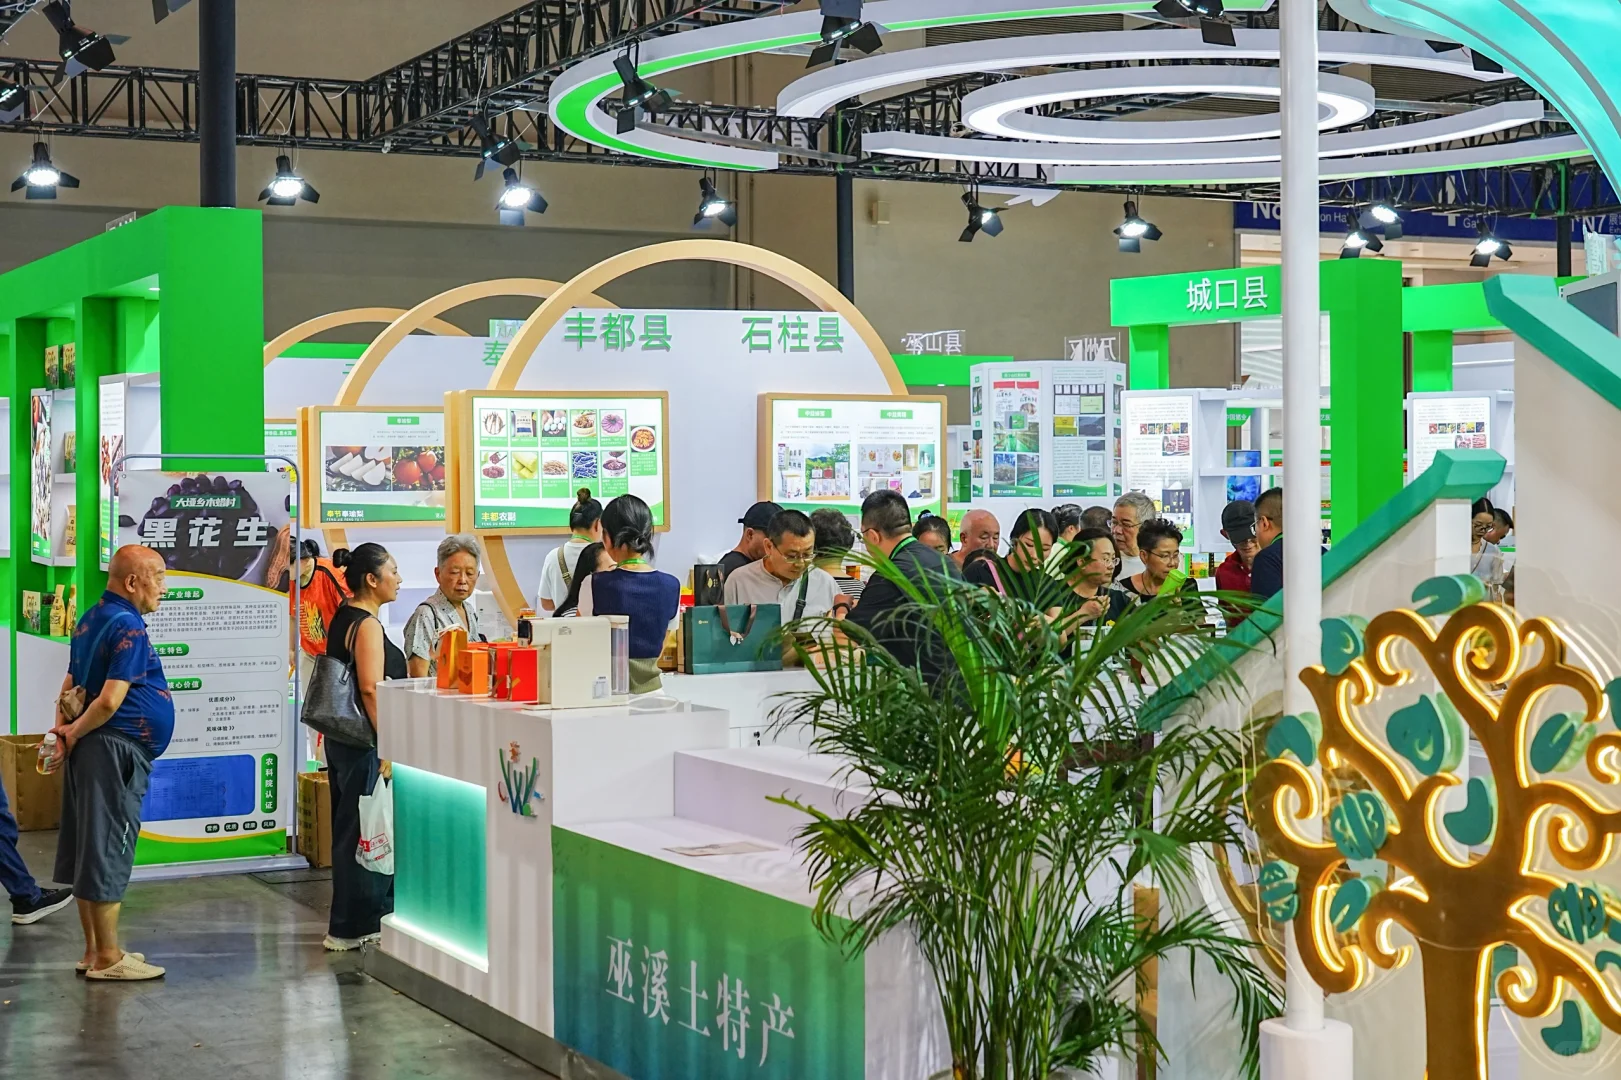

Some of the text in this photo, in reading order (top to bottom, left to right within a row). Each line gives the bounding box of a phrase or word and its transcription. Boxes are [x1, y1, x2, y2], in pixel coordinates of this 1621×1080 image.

[1186, 276, 1268, 312] 城口县
[564, 312, 672, 351] 丰都县
[741, 315, 844, 354] 石柱县
[141, 517, 270, 548] 黑花生
[155, 646, 183, 655] 生特色
[264, 757, 274, 809] 农科院认证
[605, 935, 795, 1068] 巫溪土特产
